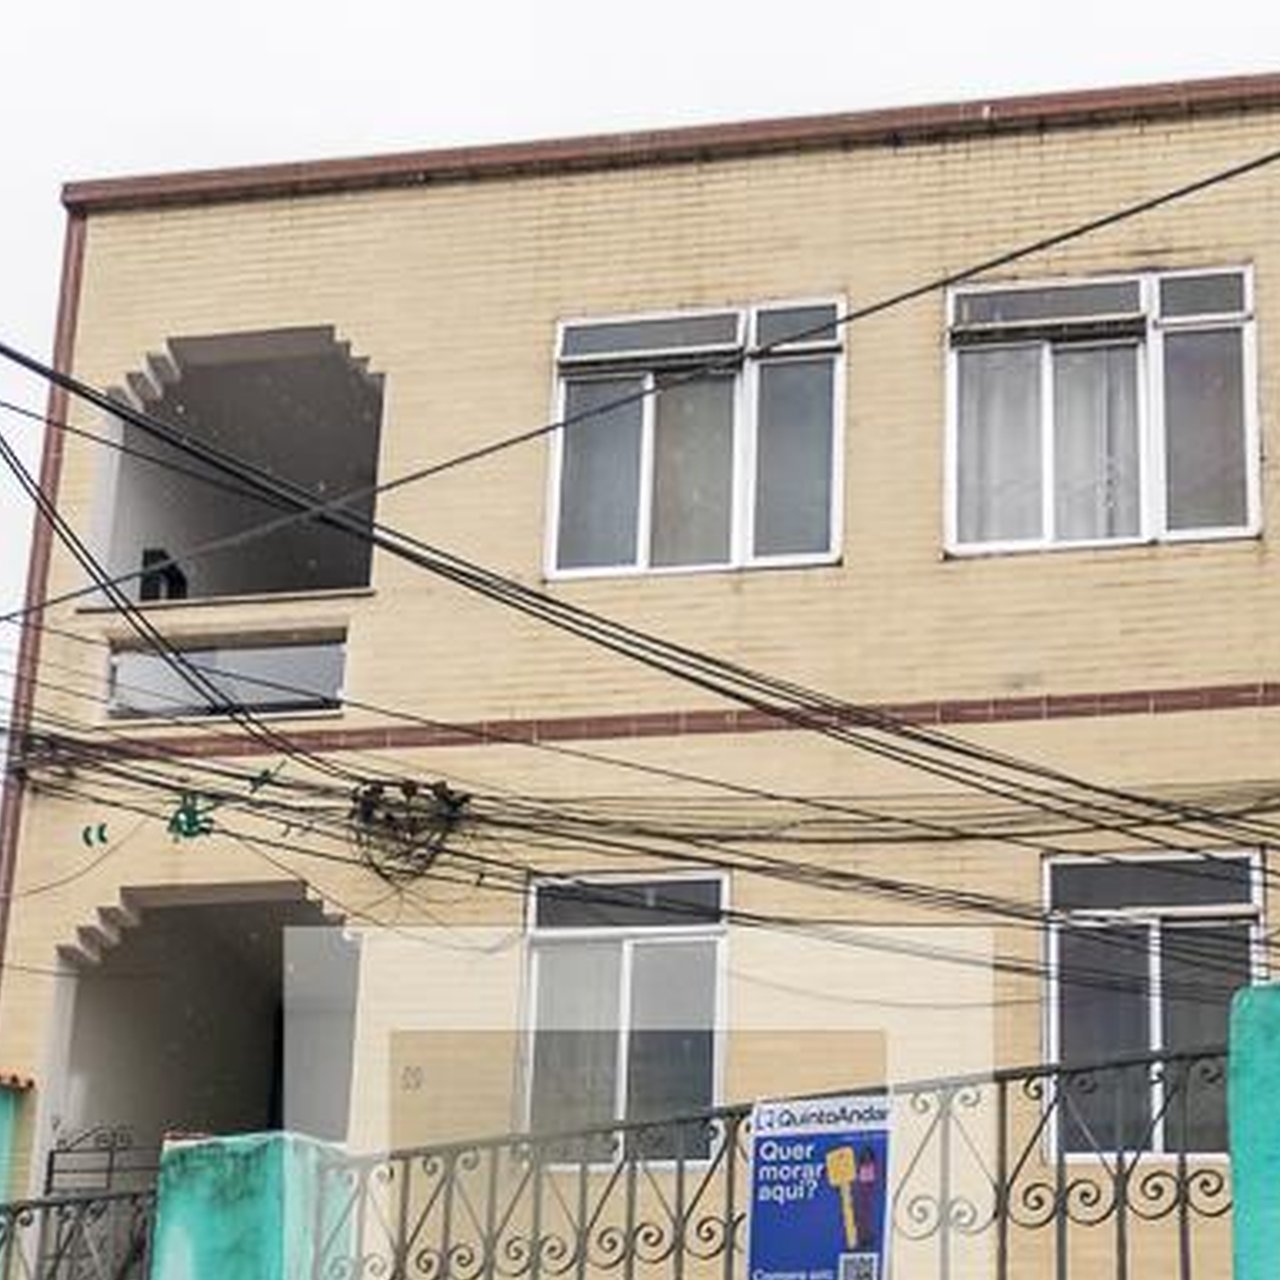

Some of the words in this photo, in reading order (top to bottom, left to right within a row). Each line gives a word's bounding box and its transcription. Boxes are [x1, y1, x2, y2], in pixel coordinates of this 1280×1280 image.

[759, 1141, 816, 1160] Quer
[759, 1163, 824, 1181] morar
[759, 1180, 818, 1205] aqui?
